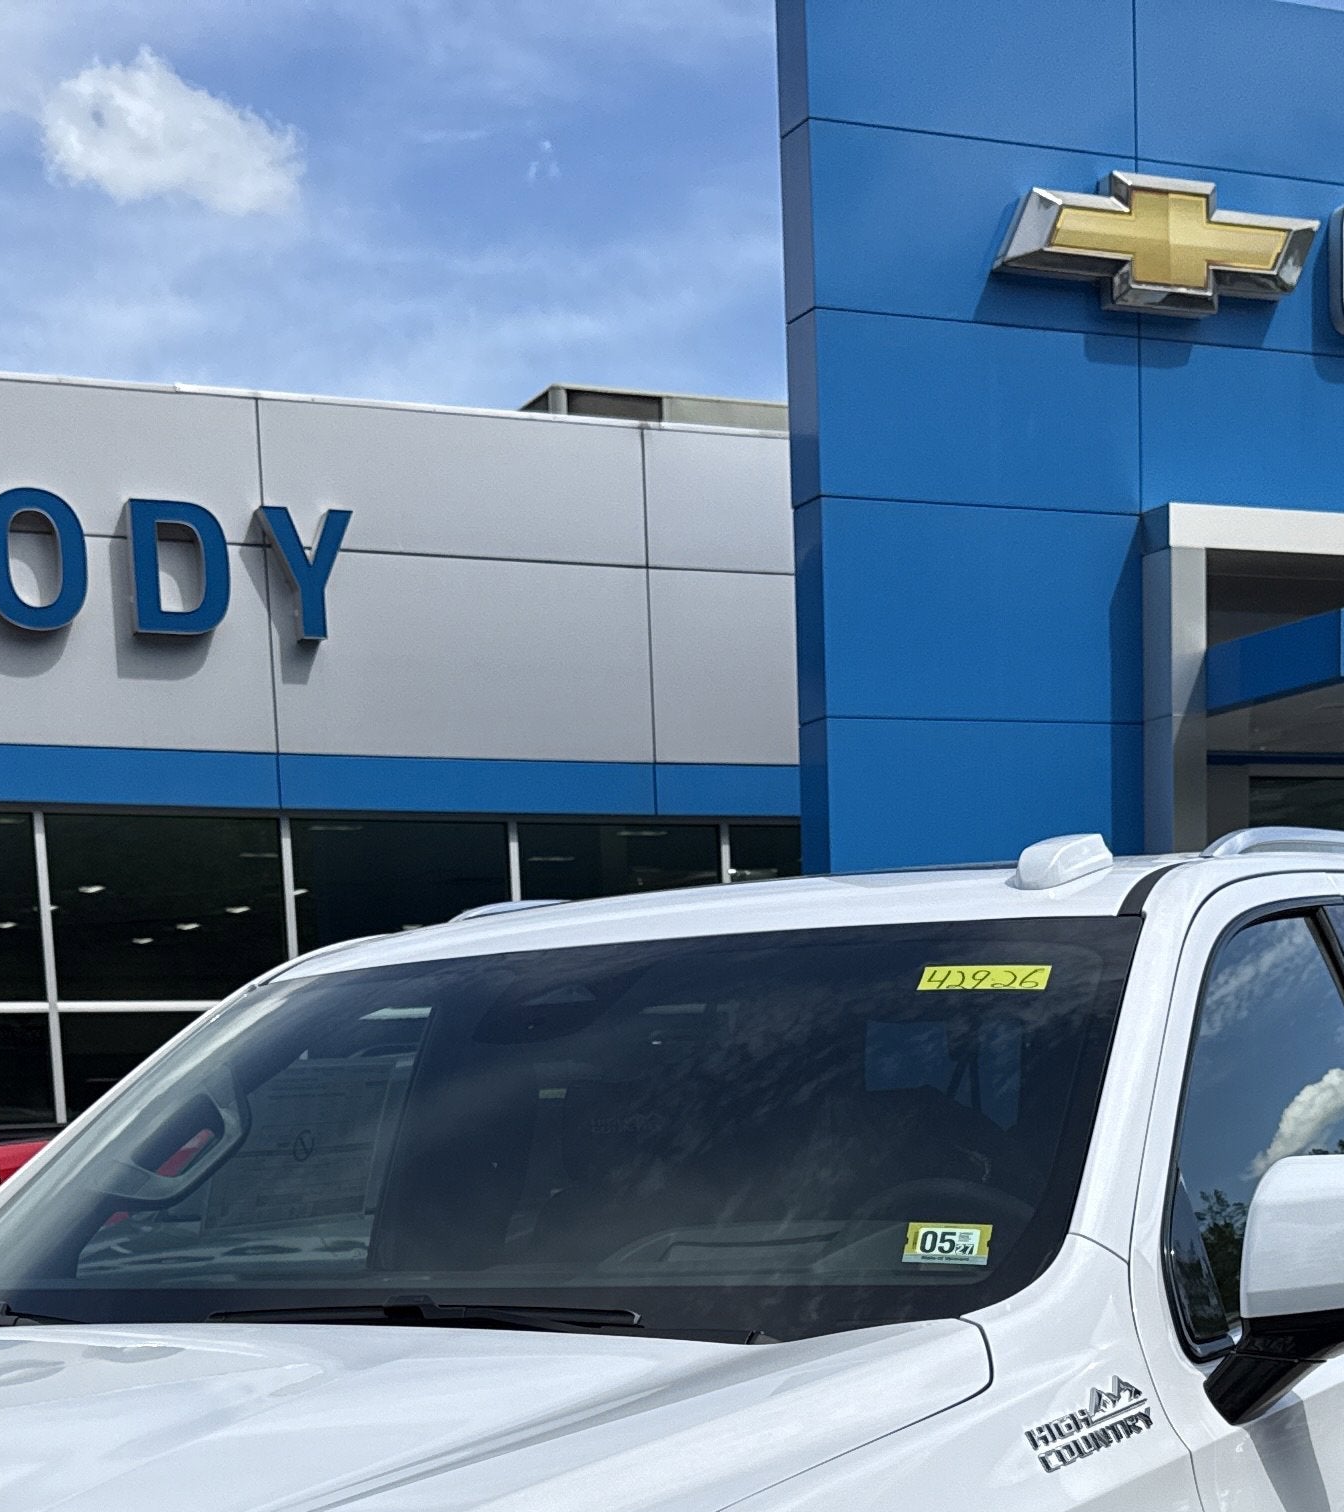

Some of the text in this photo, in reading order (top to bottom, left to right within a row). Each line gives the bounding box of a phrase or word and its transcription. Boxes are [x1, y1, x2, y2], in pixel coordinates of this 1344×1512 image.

[920, 1230, 957, 1254] 05
[1024, 1408, 1094, 1451] HIGH
[1037, 1406, 1154, 1473] COUNTRY
